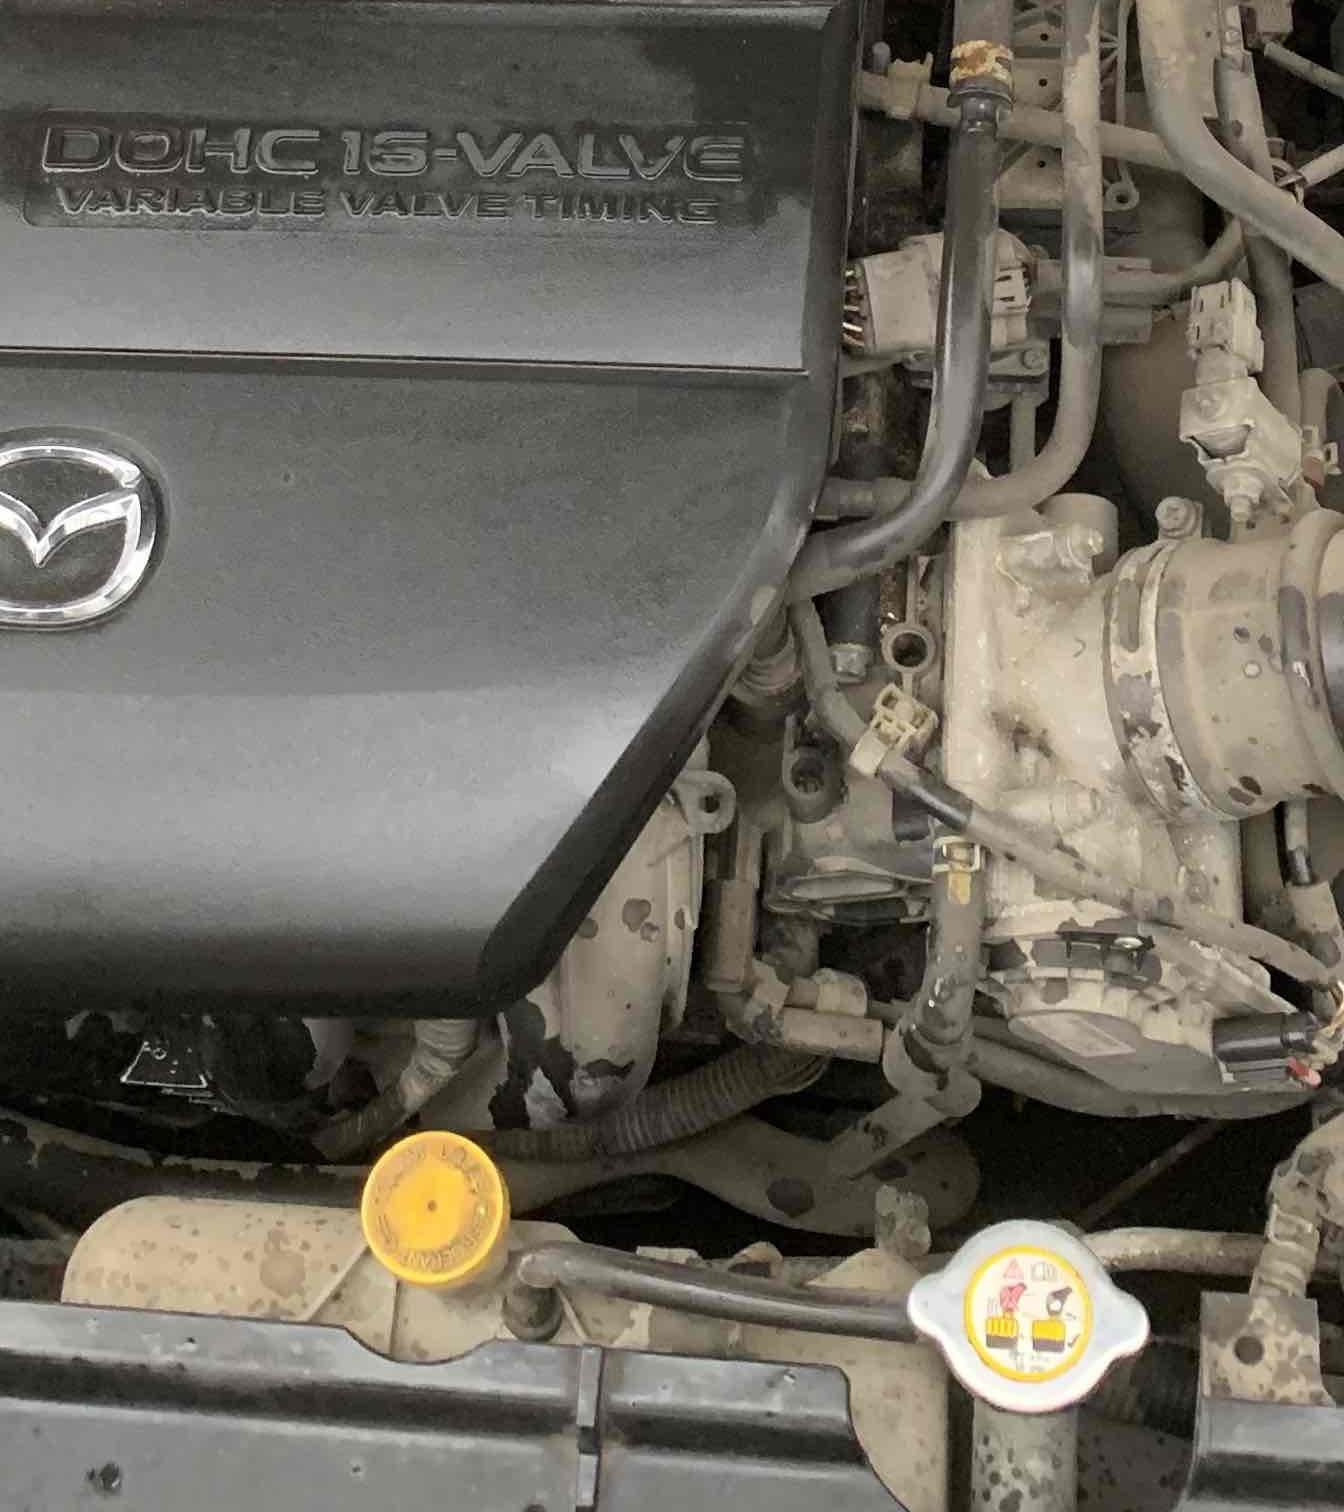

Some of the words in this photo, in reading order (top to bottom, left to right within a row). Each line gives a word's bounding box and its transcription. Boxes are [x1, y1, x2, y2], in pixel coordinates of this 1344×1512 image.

[40, 125, 320, 176] DOHC
[340, 128, 746, 184] 16-VALVE
[56, 186, 327, 219] VARIABLE
[338, 190, 507, 222] VALVE
[524, 192, 719, 226] TIMING
